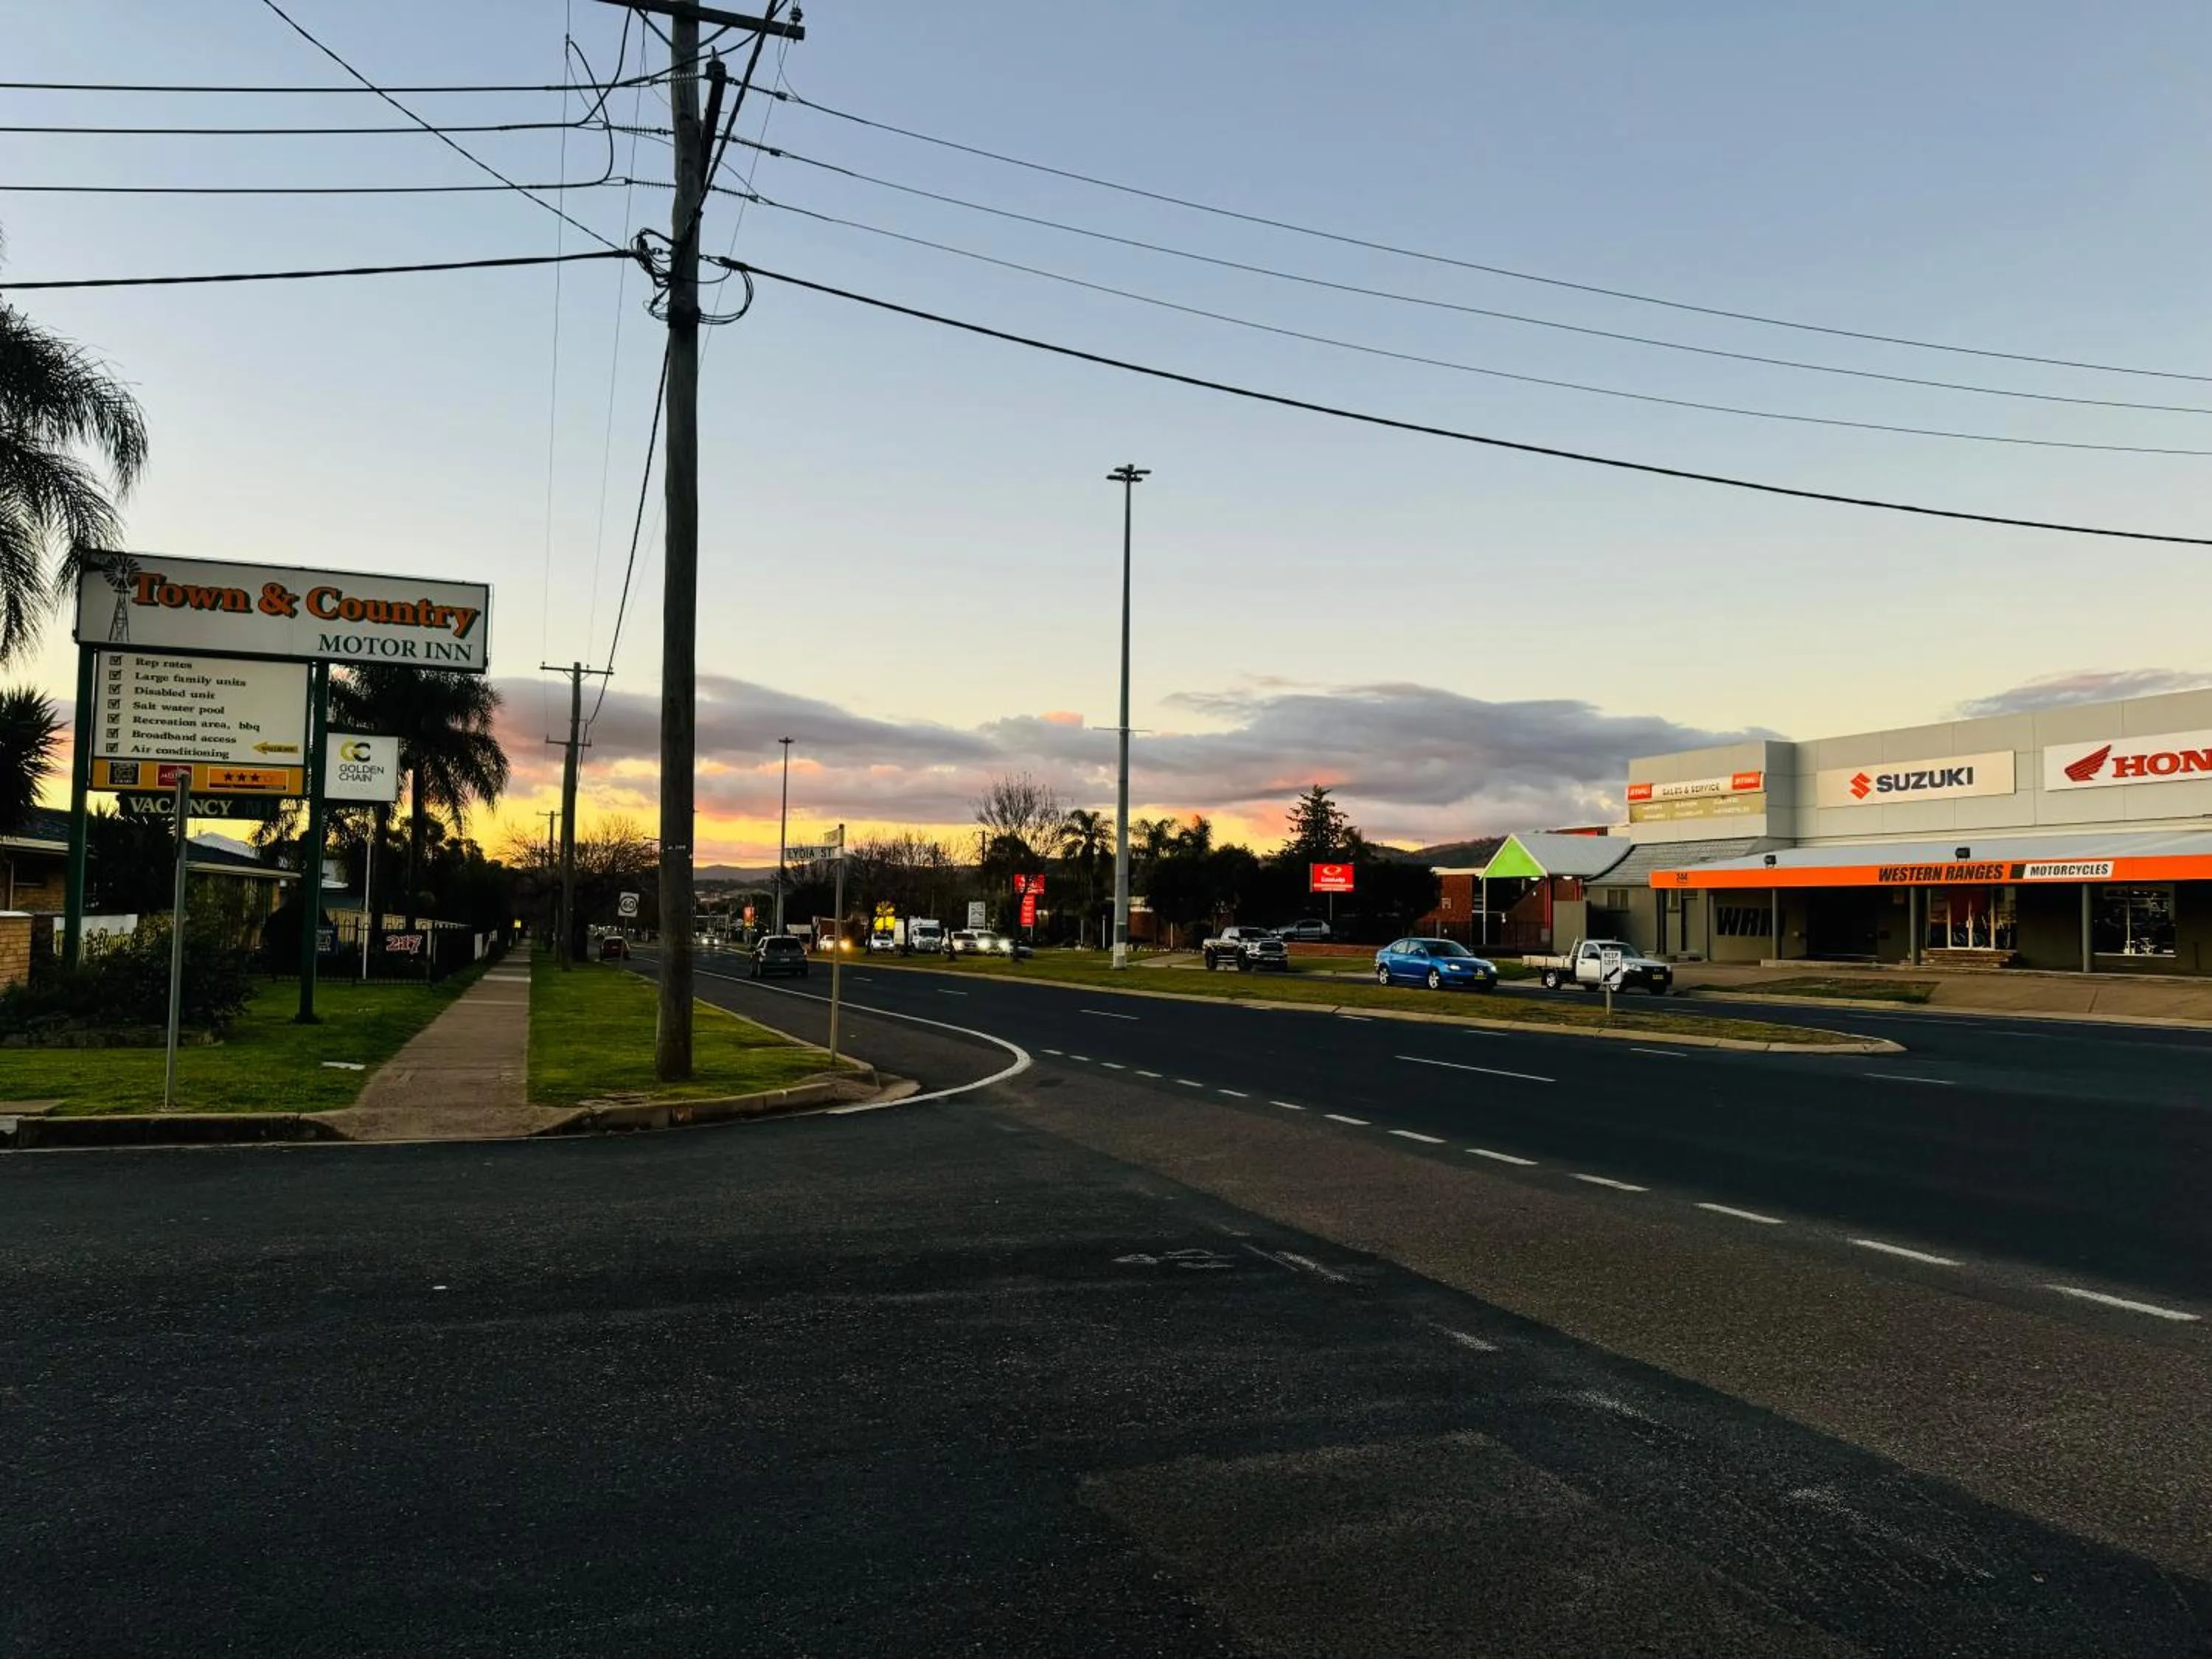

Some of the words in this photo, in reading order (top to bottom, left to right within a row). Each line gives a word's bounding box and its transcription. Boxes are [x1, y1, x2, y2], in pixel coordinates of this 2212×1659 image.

[130, 572, 254, 613] Town
[258, 582, 299, 618] &
[306, 586, 481, 639] Country
[319, 634, 417, 658] MOTOR
[424, 641, 472, 661] INN
[135, 657, 159, 669] Rep
[163, 661, 192, 669] rates
[135, 672, 169, 684] Large
[173, 674, 212, 686] family
[215, 678, 246, 686] units
[134, 686, 186, 698] Disabled
[190, 691, 215, 700] unit
[133, 701, 156, 711] Salt
[161, 704, 195, 713] water
[198, 706, 224, 716] pool
[133, 716, 197, 727] Recreation
[238, 721, 260, 733] bbq
[132, 730, 197, 742] Broadband
[201, 736, 237, 744] access
[130, 744, 151, 753] Air
[155, 748, 230, 760] conditioning
[339, 763, 384, 775] GOLDEN
[2111, 748, 2212, 778] HON
[338, 772, 372, 782] CHAIN
[1877, 766, 1974, 793] SUZUKI
[1691, 783, 1720, 793] SERVICE
[128, 796, 234, 815] VACNCY
[788, 848, 815, 859] LYDIA
[820, 847, 832, 858] ST
[1878, 864, 1943, 883] WESTERN
[1944, 863, 2004, 881] RANGES
[2029, 863, 2109, 877] MOTORCYCLES
